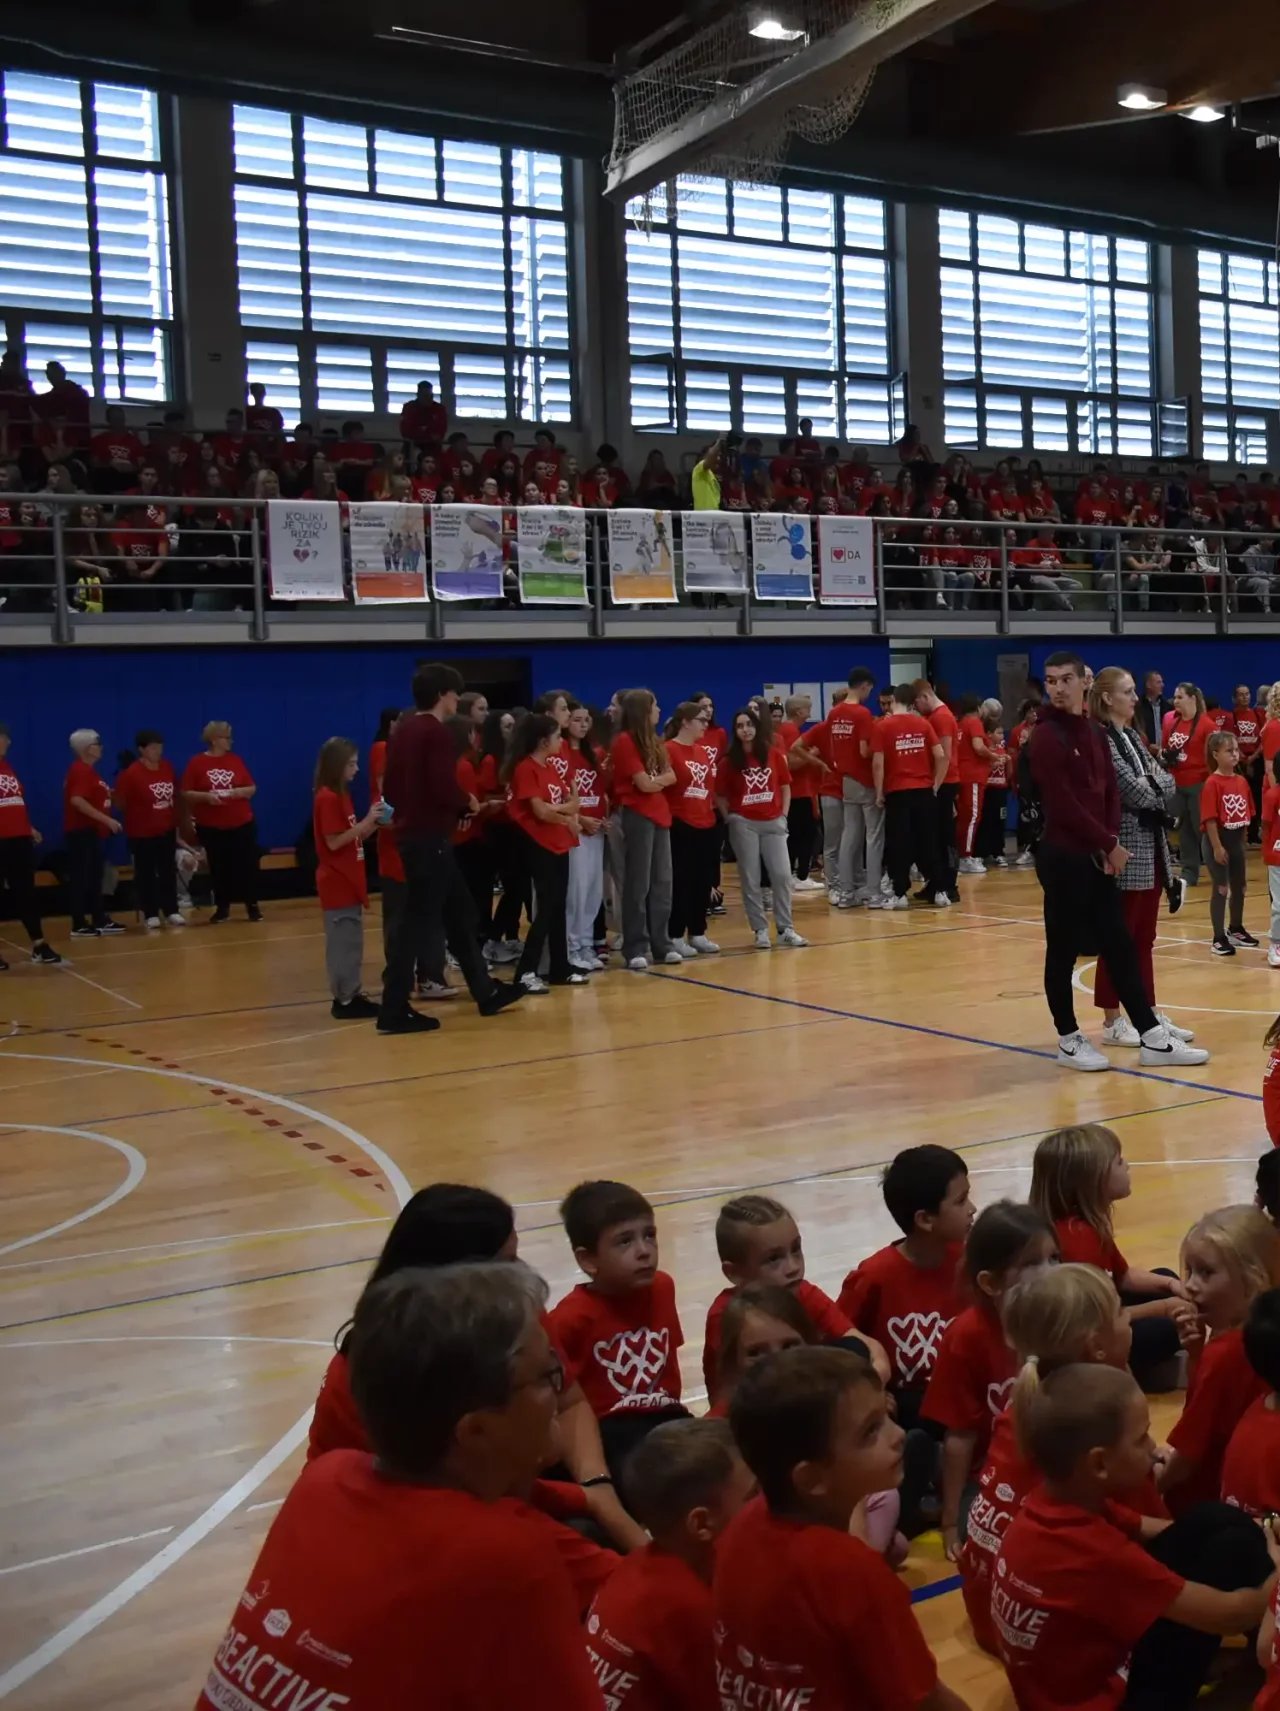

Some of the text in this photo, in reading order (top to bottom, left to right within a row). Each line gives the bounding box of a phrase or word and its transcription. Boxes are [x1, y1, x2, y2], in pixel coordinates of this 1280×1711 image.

[286, 512, 323, 521] KOLIKI
[283, 521, 328, 530] JE TVOJ
[291, 530, 320, 539] RIZIK
[296, 539, 311, 547] ZA
[312, 550, 318, 560] ?
[847, 551, 861, 559] DA
